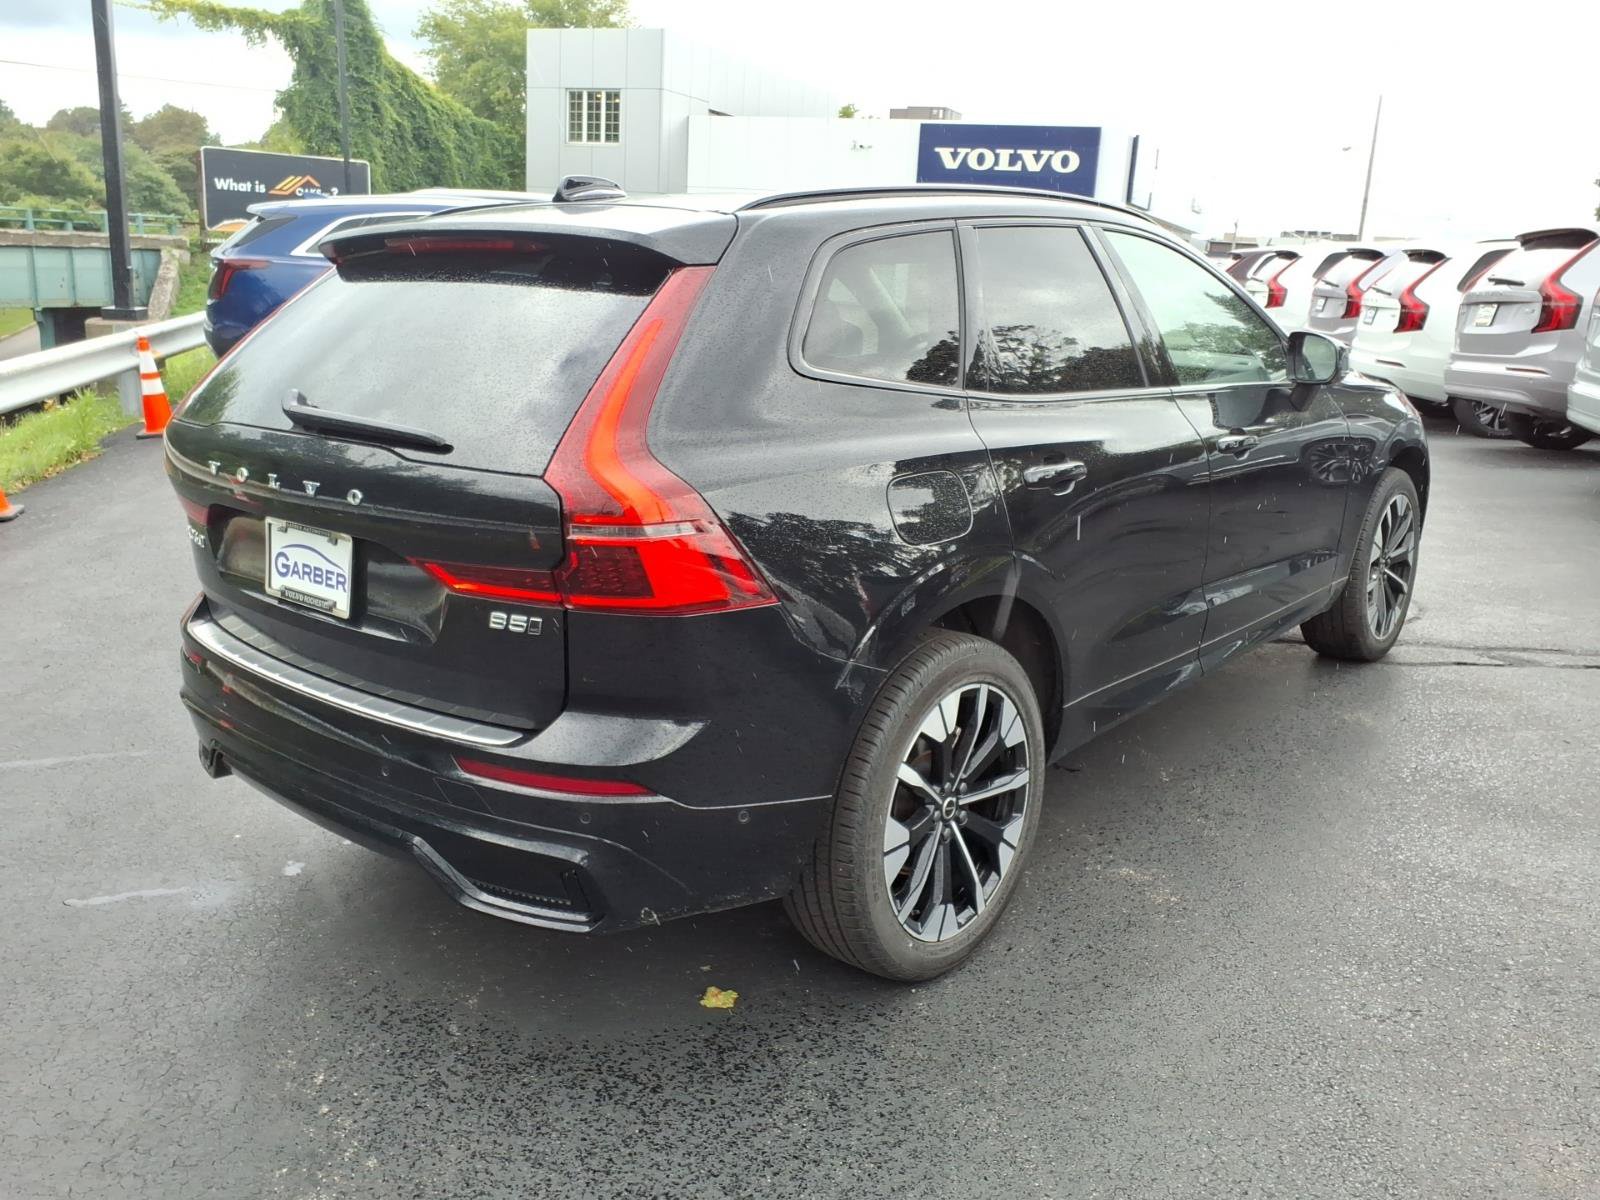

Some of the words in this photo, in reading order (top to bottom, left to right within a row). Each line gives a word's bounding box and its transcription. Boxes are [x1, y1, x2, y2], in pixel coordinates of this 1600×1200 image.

[934, 147, 1080, 174] VOLVO
[214, 177, 252, 193] What
[255, 180, 266, 194] is
[208, 460, 363, 506] VOLVO
[274, 551, 347, 593] GARBER
